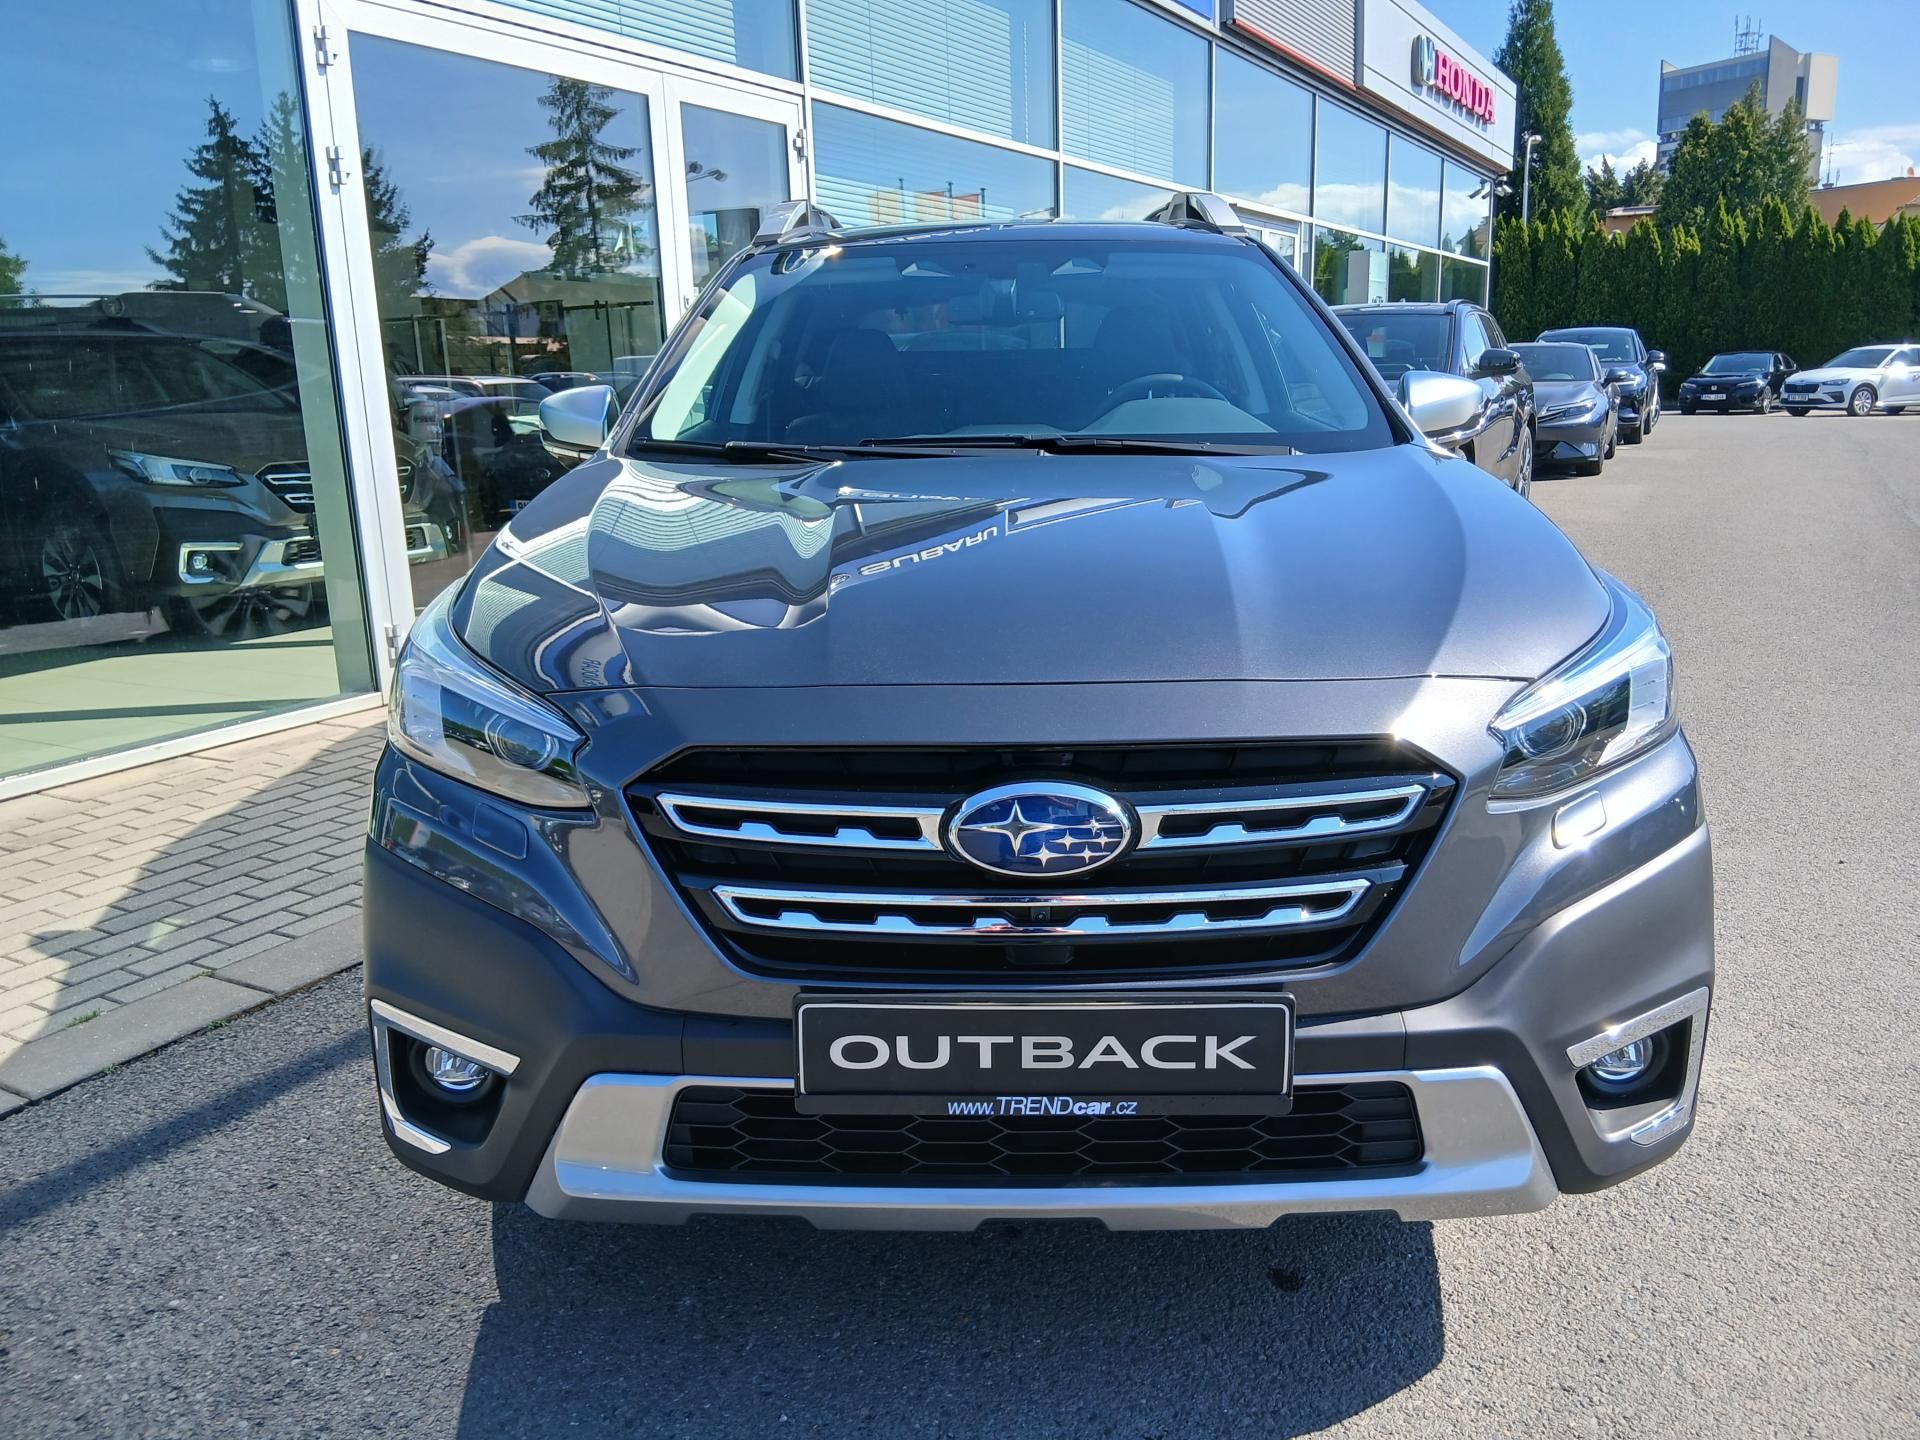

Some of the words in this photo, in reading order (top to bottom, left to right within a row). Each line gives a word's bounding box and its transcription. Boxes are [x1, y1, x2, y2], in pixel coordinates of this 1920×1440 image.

[1434, 49, 1496, 124] HONDA
[829, 1034, 1257, 1070] OUTBACK
[947, 1096, 1138, 1115] www.TRENDcar.cz
